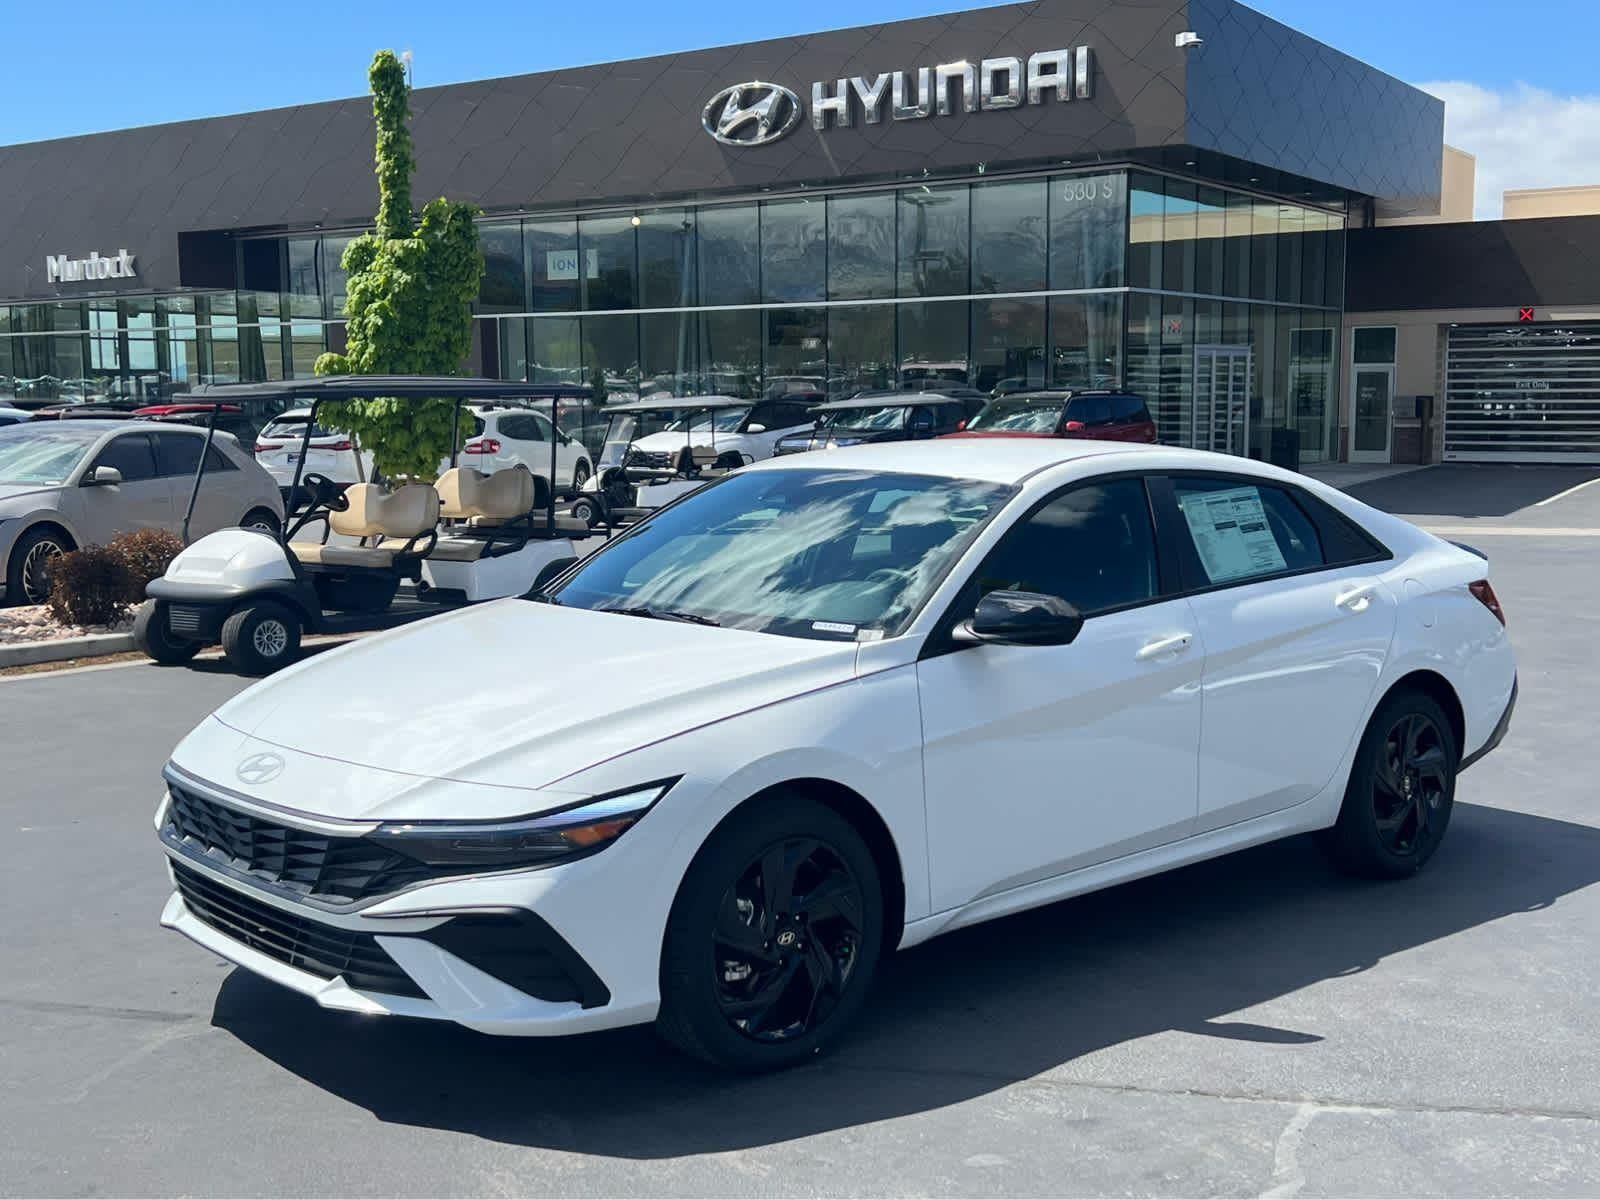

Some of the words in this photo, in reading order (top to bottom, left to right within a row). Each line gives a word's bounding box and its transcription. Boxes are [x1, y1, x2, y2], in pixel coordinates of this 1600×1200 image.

[811, 45, 1090, 131] HYUNDAI
[1103, 180, 1113, 199] S
[47, 249, 136, 282] Murdock
[1532, 378, 1550, 392] Only
